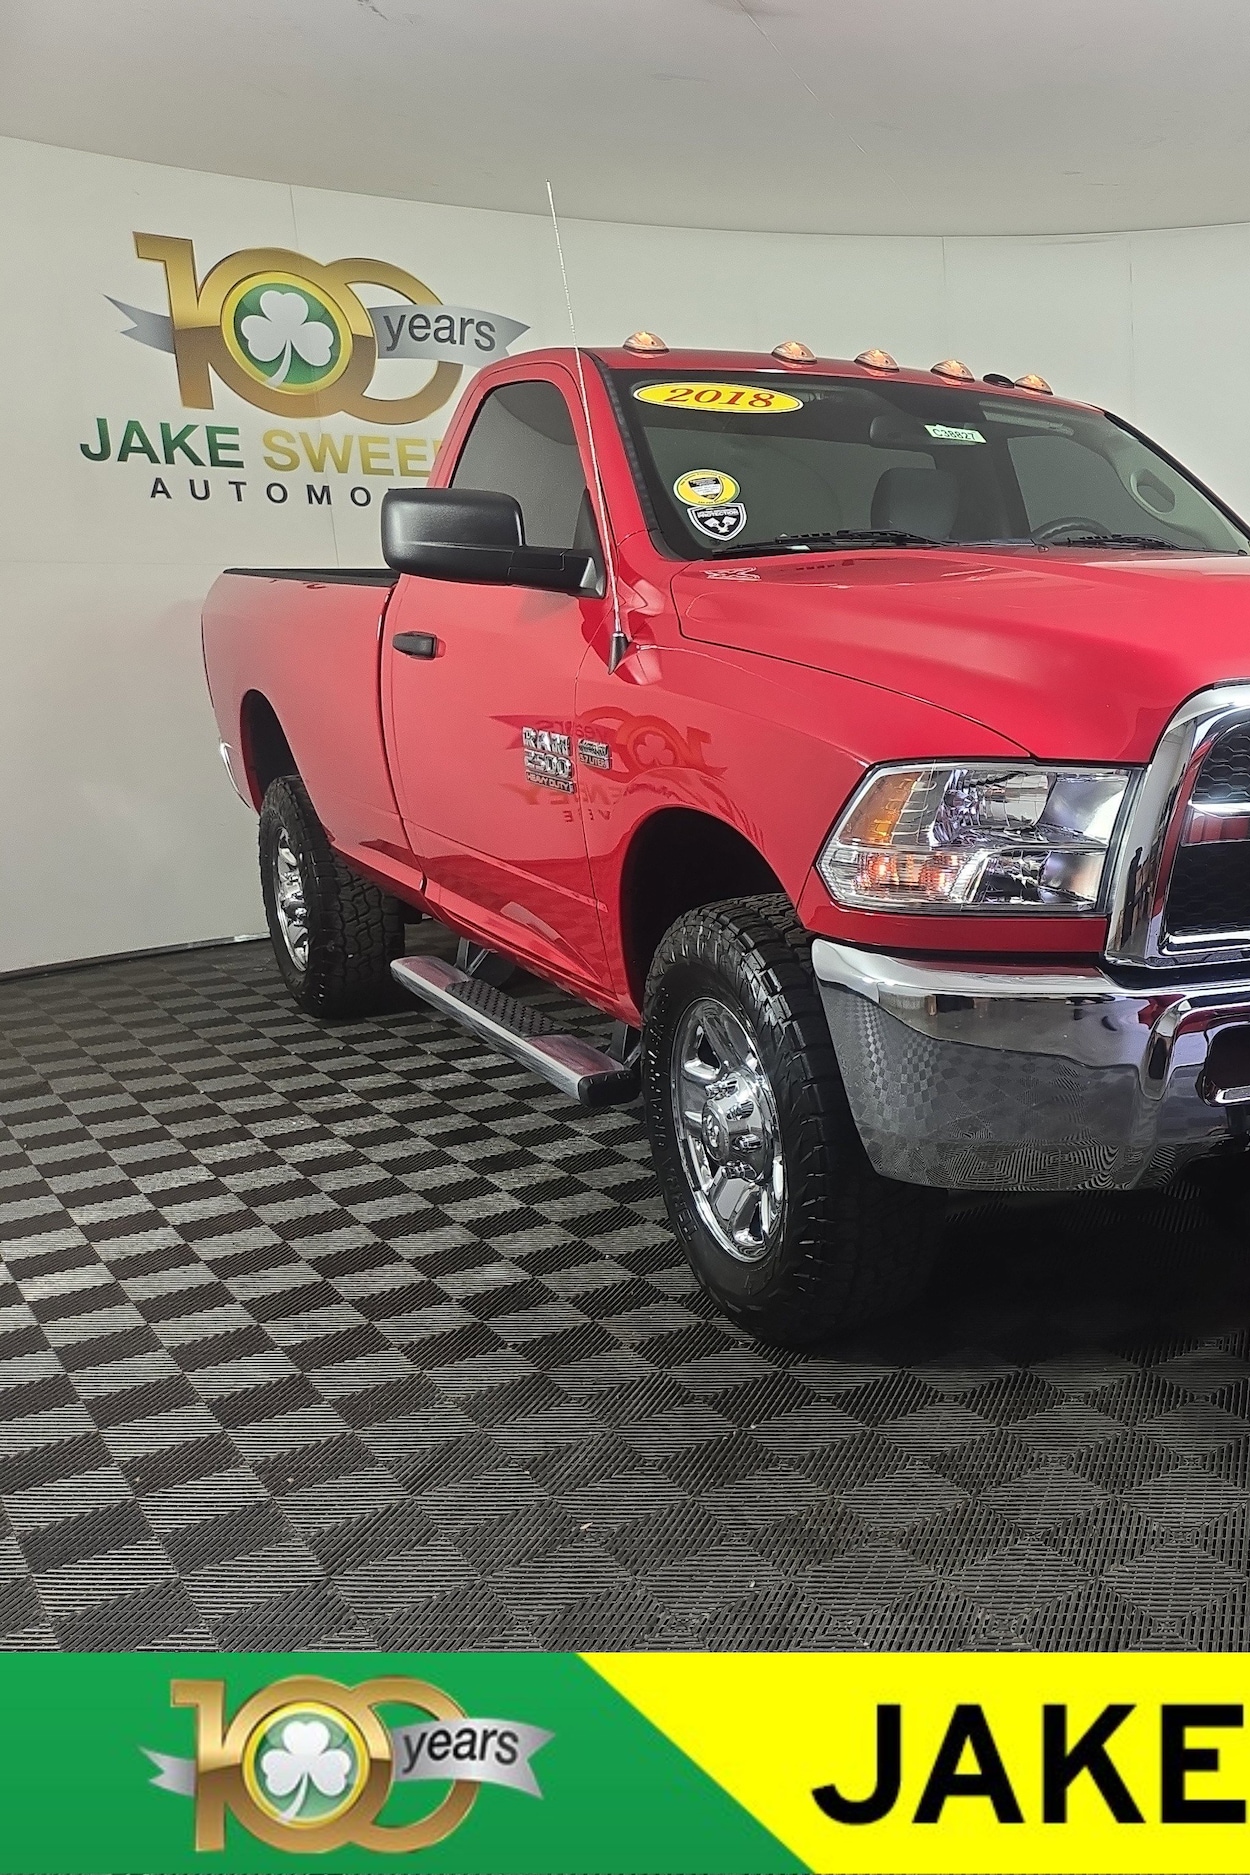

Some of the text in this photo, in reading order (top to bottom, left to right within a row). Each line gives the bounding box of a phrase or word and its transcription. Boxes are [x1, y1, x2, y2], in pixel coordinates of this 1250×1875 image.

[381, 312, 498, 352] years
[663, 388, 775, 408] 2018
[79, 417, 442, 478] JAKE SWEE
[522, 726, 571, 757] RAM
[524, 748, 572, 779] 2500
